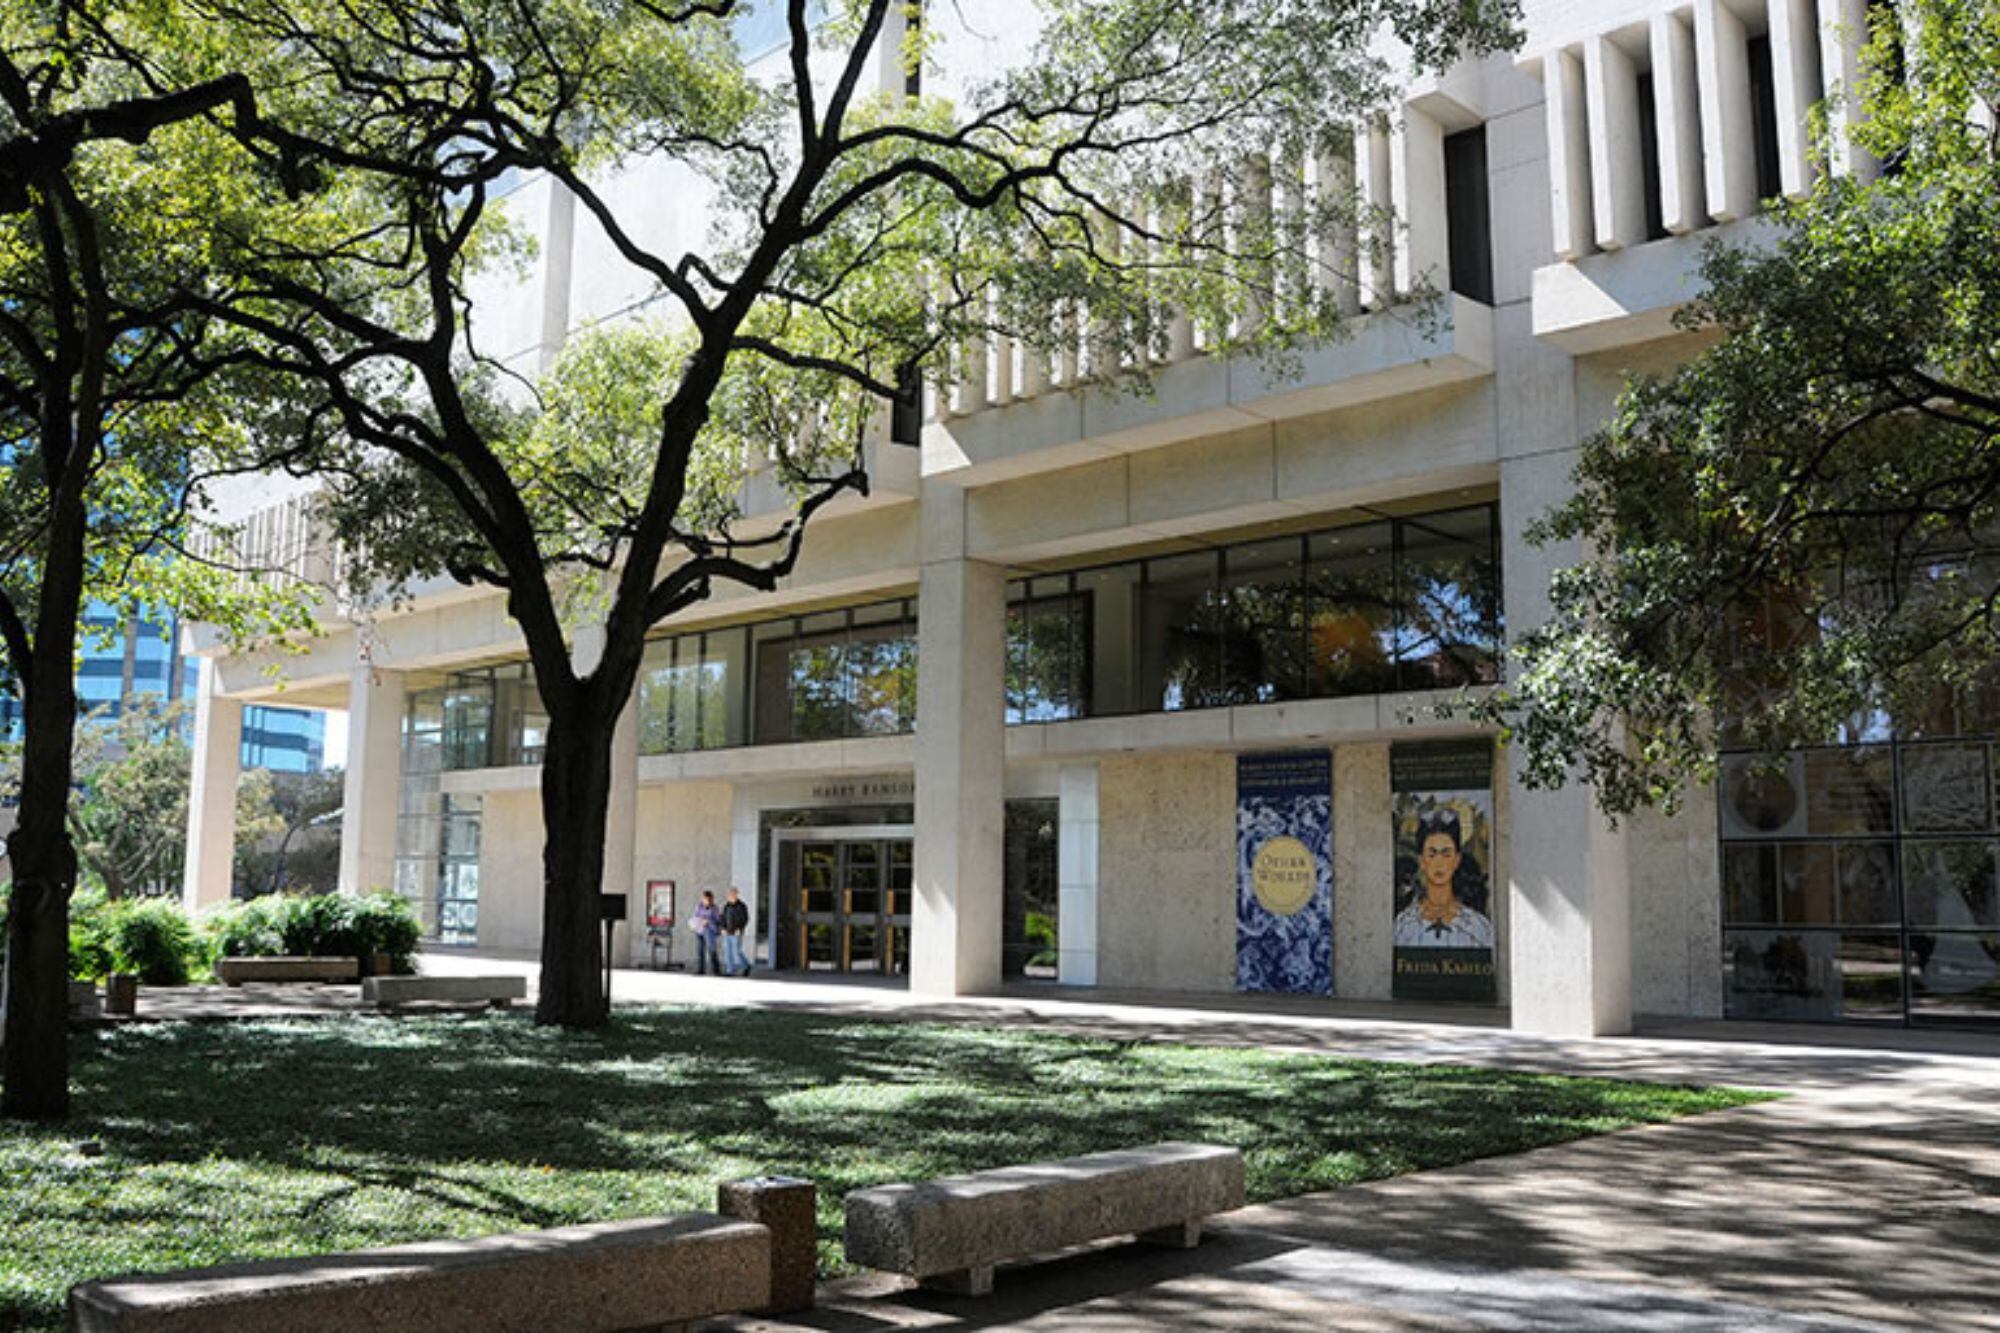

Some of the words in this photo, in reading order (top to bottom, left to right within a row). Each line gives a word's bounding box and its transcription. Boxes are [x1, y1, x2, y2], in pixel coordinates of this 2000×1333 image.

[861, 782, 914, 796] RANSO
[1397, 958, 1439, 974] FRIDA
[1441, 958, 1495, 975] KAHLO
